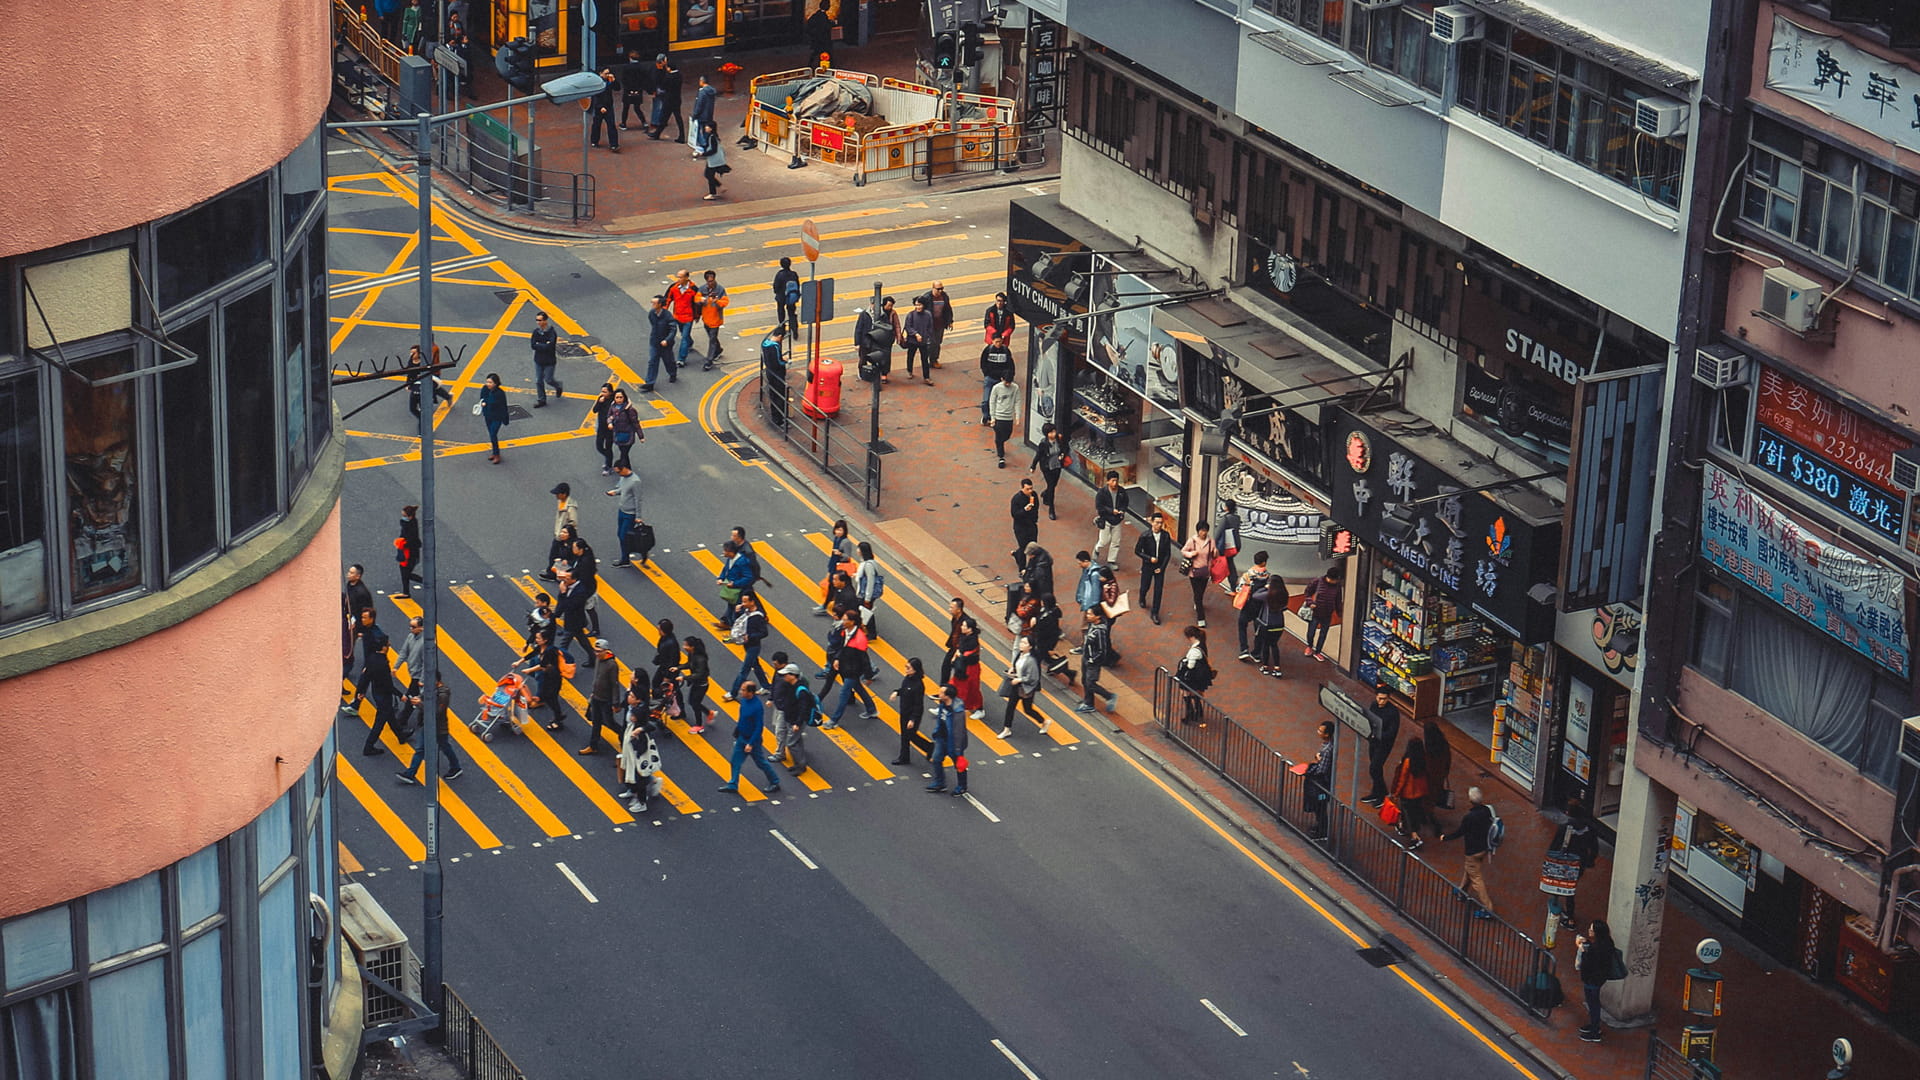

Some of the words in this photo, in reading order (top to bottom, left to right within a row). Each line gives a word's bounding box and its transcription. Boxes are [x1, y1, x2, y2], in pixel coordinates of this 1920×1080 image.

[1012, 277, 1031, 298] CITY
[1032, 288, 1059, 317] CHAIN
[1469, 386, 1497, 404] Espresso
[1762, 369, 1859, 443] 美姿妍肌
[1791, 451, 1839, 499] $380
[1708, 469, 1799, 559] 英利財務
[1706, 538, 1773, 592] 中港車牌
[1707, 503, 1748, 551] 樓宇按揭
[1855, 601, 1904, 645] 企業融資
[1700, 946, 1721, 958] 12AB
[1833, 1044, 1846, 1061] 5M
